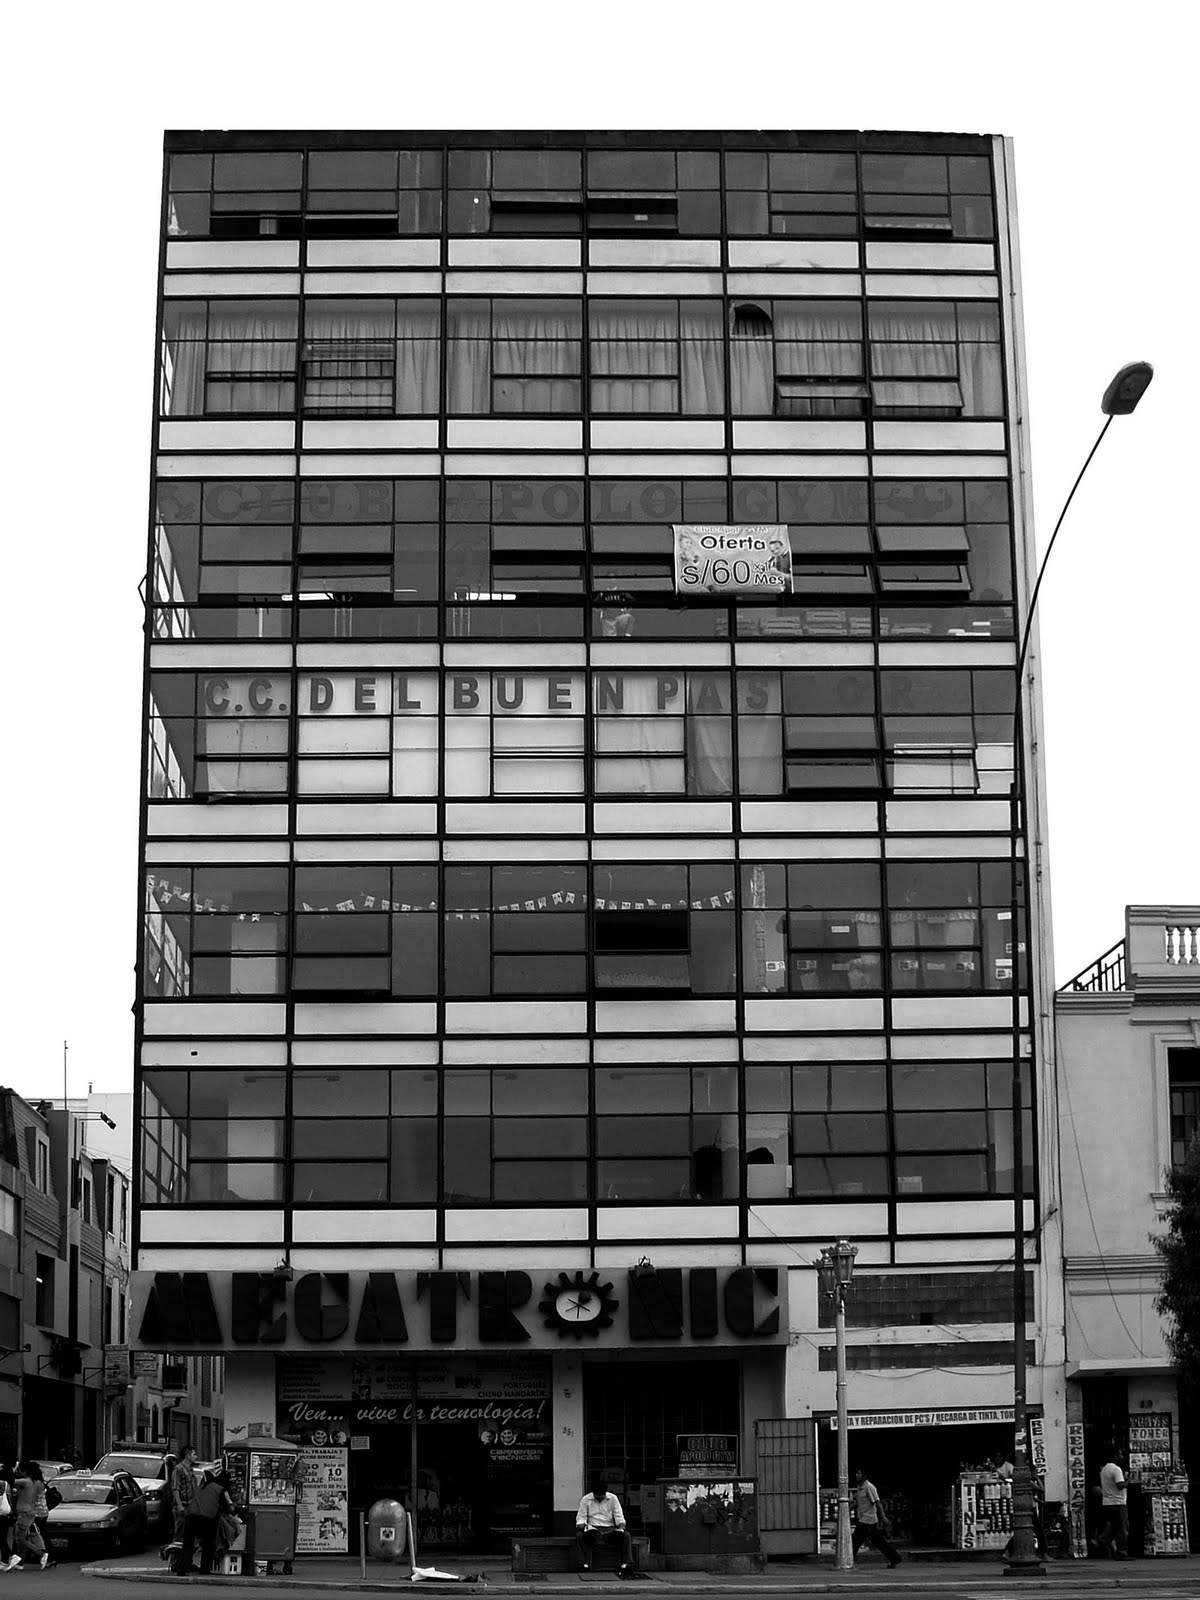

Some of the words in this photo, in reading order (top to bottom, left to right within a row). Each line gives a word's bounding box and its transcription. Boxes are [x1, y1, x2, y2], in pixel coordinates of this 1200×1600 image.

[700, 535, 766, 550] Oferta
[754, 573, 785, 585] Mes
[204, 677, 288, 713] C.C.
[309, 676, 422, 711] DEL
[452, 675, 625, 711] BUEN
[137, 1267, 780, 1345] MEGATRONIC
[288, 1401, 345, 1421] Ven...
[356, 1404, 398, 1421] vive
[861, 1414, 904, 1426] REPARACION
[904, 1414, 914, 1424] DE
[914, 1413, 931, 1424] PC'S
[936, 1411, 968, 1423] RECARGA
[968, 1411, 978, 1421] DE
[687, 1437, 728, 1451] CLUB
[680, 1450, 712, 1462] APOLO
[328, 1468, 343, 1476] 10
[1068, 1425, 1085, 1510] RECARGAS
[963, 1484, 976, 1548] TINTAS
